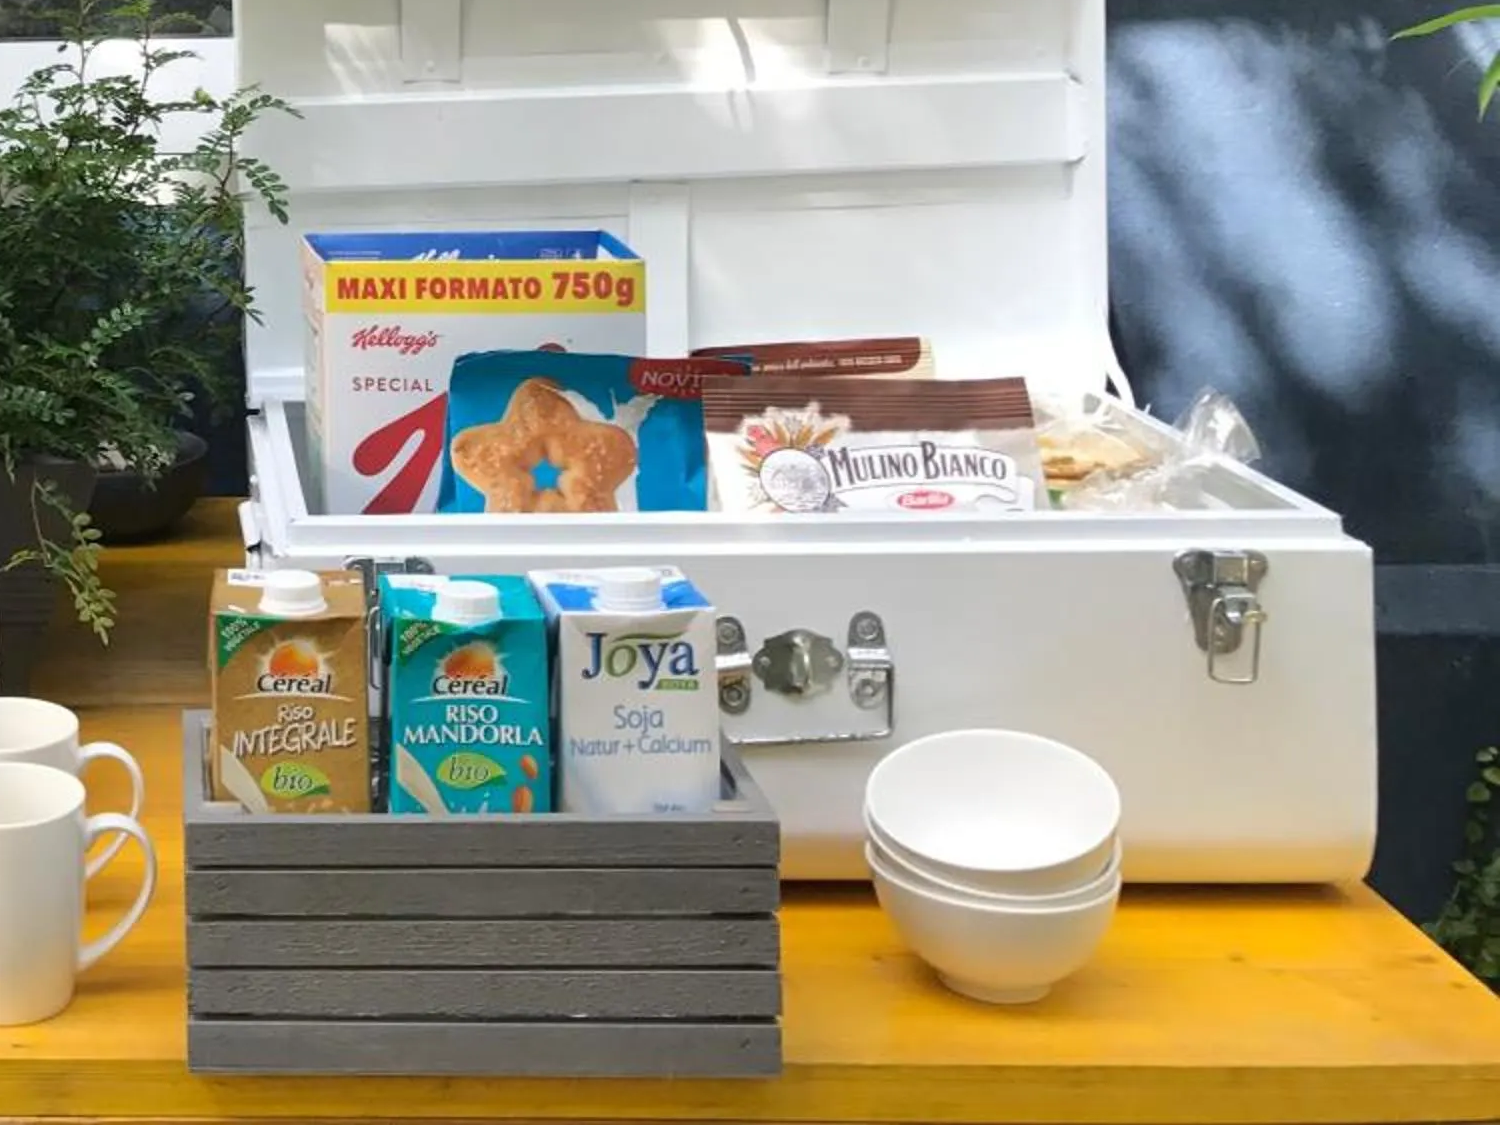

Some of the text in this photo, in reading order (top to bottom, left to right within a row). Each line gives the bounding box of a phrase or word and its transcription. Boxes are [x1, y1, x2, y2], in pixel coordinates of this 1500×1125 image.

[337, 271, 635, 307] MAXI FORMATO 750g
[352, 324, 441, 355] Kellogg's
[352, 376, 434, 393] SPECIAL
[640, 369, 701, 388] NOVI
[828, 440, 1007, 487] MULINO BIANCO
[581, 632, 700, 690] Joya
[257, 672, 332, 694] Céréal
[432, 674, 509, 695] Céréal
[445, 704, 499, 723] RISO
[613, 704, 664, 734] Soja
[233, 718, 358, 758] INTEGRALE
[403, 725, 544, 746] MANDORLA
[637, 734, 711, 754] Calcium
[273, 766, 314, 790] bio
[450, 756, 491, 781] bio
